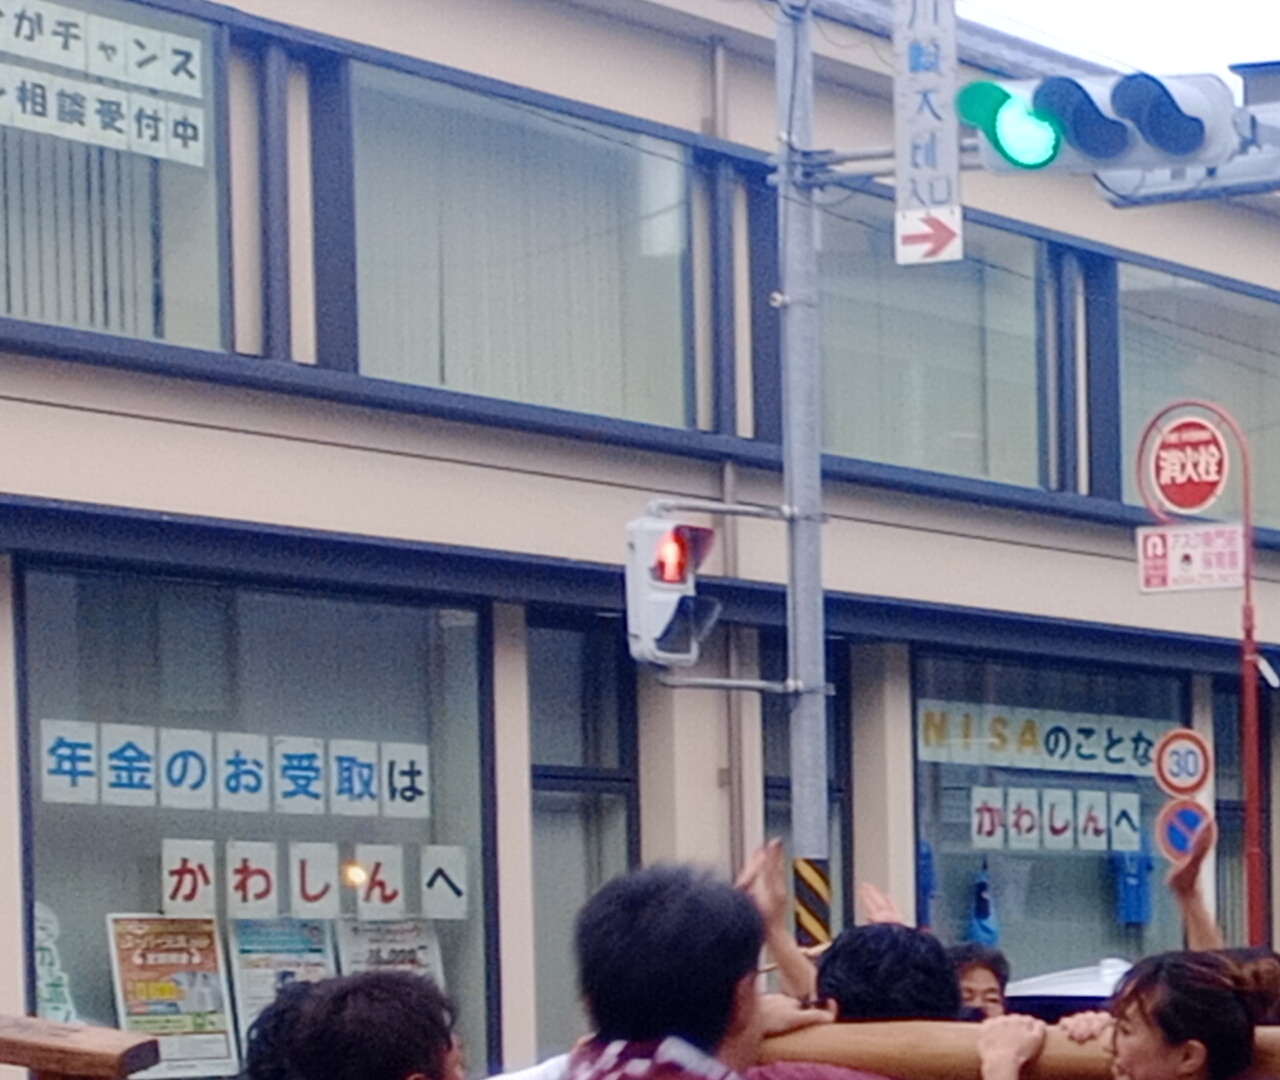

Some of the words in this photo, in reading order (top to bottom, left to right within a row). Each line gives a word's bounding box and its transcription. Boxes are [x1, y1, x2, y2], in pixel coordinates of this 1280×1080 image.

[0, 8, 196, 80] がチャンス
[0, 79, 199, 149] 相談受付中
[1158, 443, 1221, 486] 消火栓
[47, 736, 425, 802] 年金のお受取は
[1167, 749, 1201, 778] 30
[976, 801, 1139, 838] かわしんへ
[167, 857, 464, 904] かわしんへ
